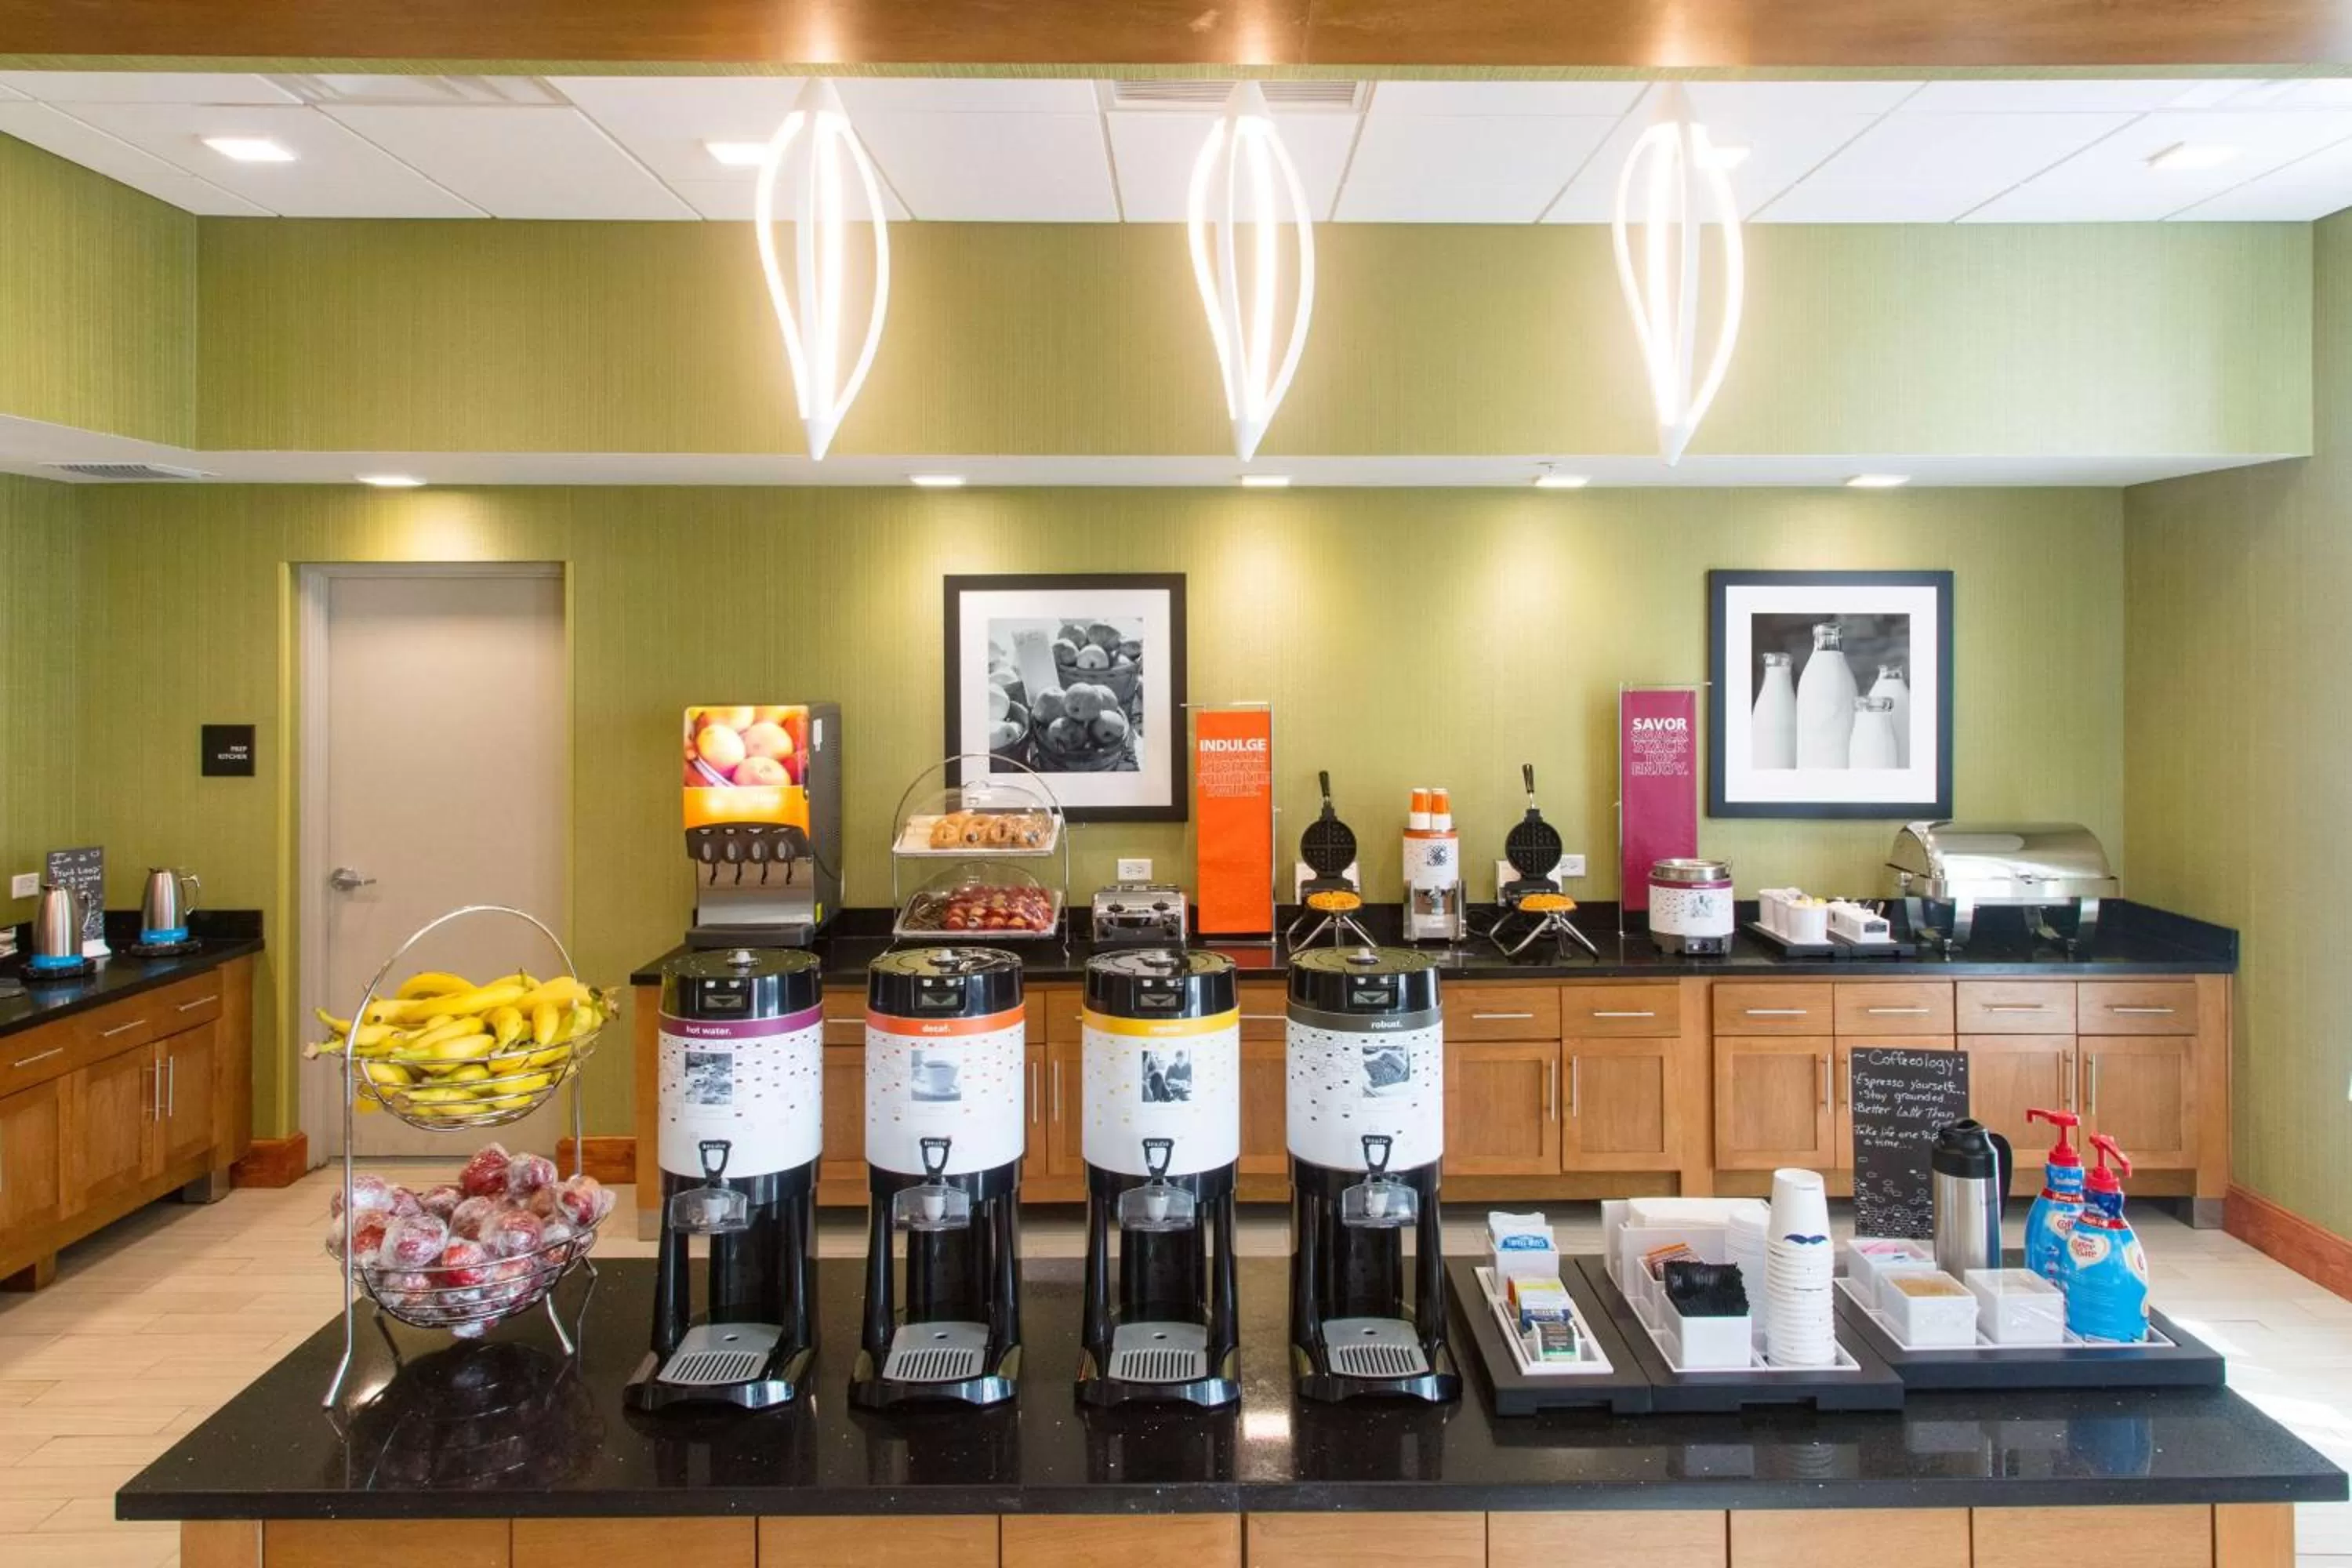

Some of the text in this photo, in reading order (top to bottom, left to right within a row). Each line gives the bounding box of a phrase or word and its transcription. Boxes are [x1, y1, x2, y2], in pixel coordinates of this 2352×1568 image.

[1632, 717, 1687, 731] SAVOR
[1200, 739, 1267, 752] INDULGE
[921, 1022, 951, 1033] decaf.
[1371, 1020, 1403, 1029] robust.
[686, 1025, 732, 1036] hot water.
